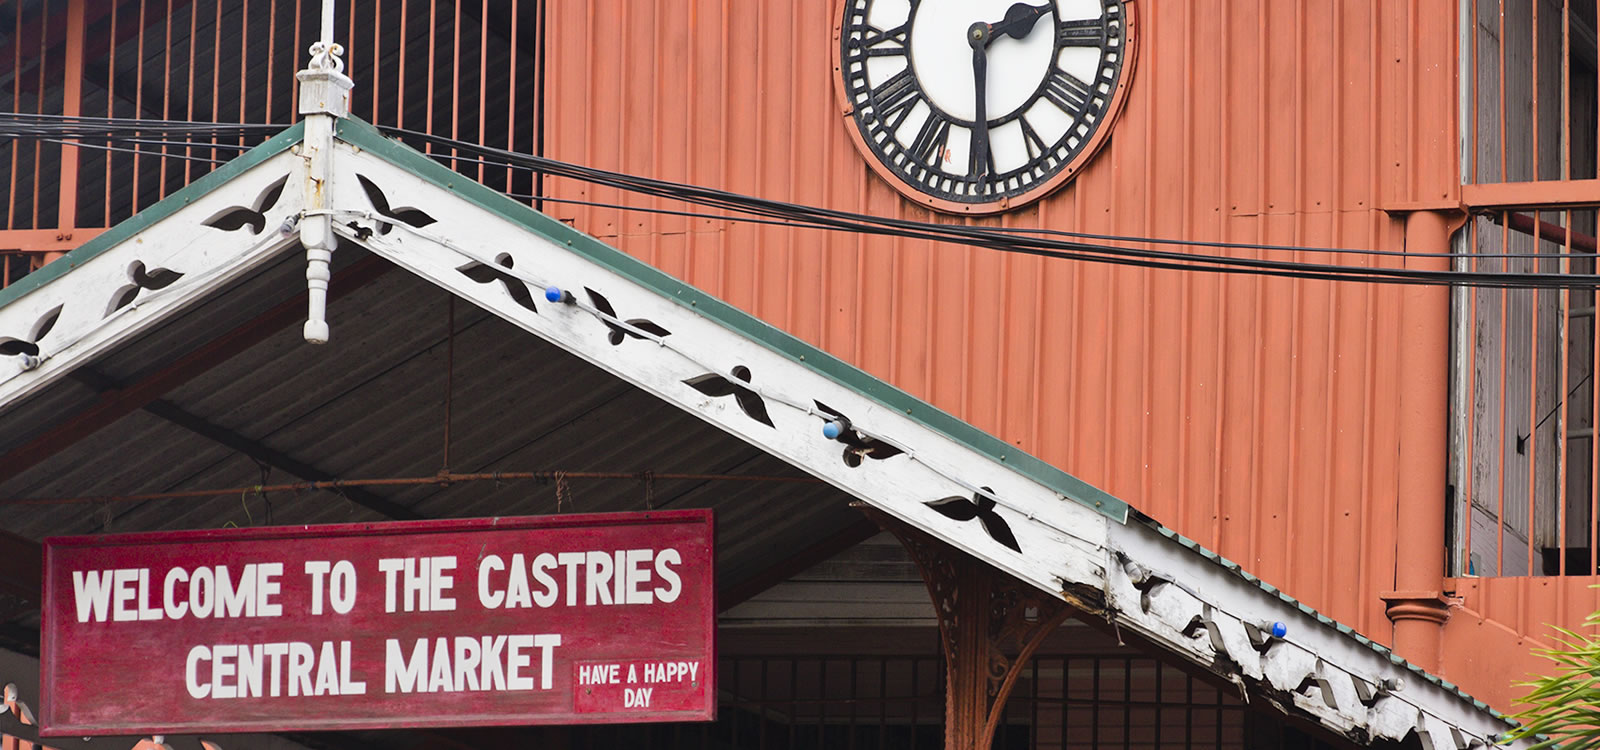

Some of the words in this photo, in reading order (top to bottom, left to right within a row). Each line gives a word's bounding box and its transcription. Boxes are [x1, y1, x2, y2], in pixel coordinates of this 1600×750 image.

[73, 563, 283, 622] WELCOME
[305, 560, 356, 615] TO
[379, 556, 457, 613] THE
[478, 549, 681, 609] CASTRIES
[186, 641, 366, 699] CENTRAL
[385, 635, 561, 693] MARKET
[579, 664, 620, 685] HAVE
[627, 664, 637, 683] A
[645, 662, 698, 683] HAPPY
[624, 688, 652, 708] DAY
